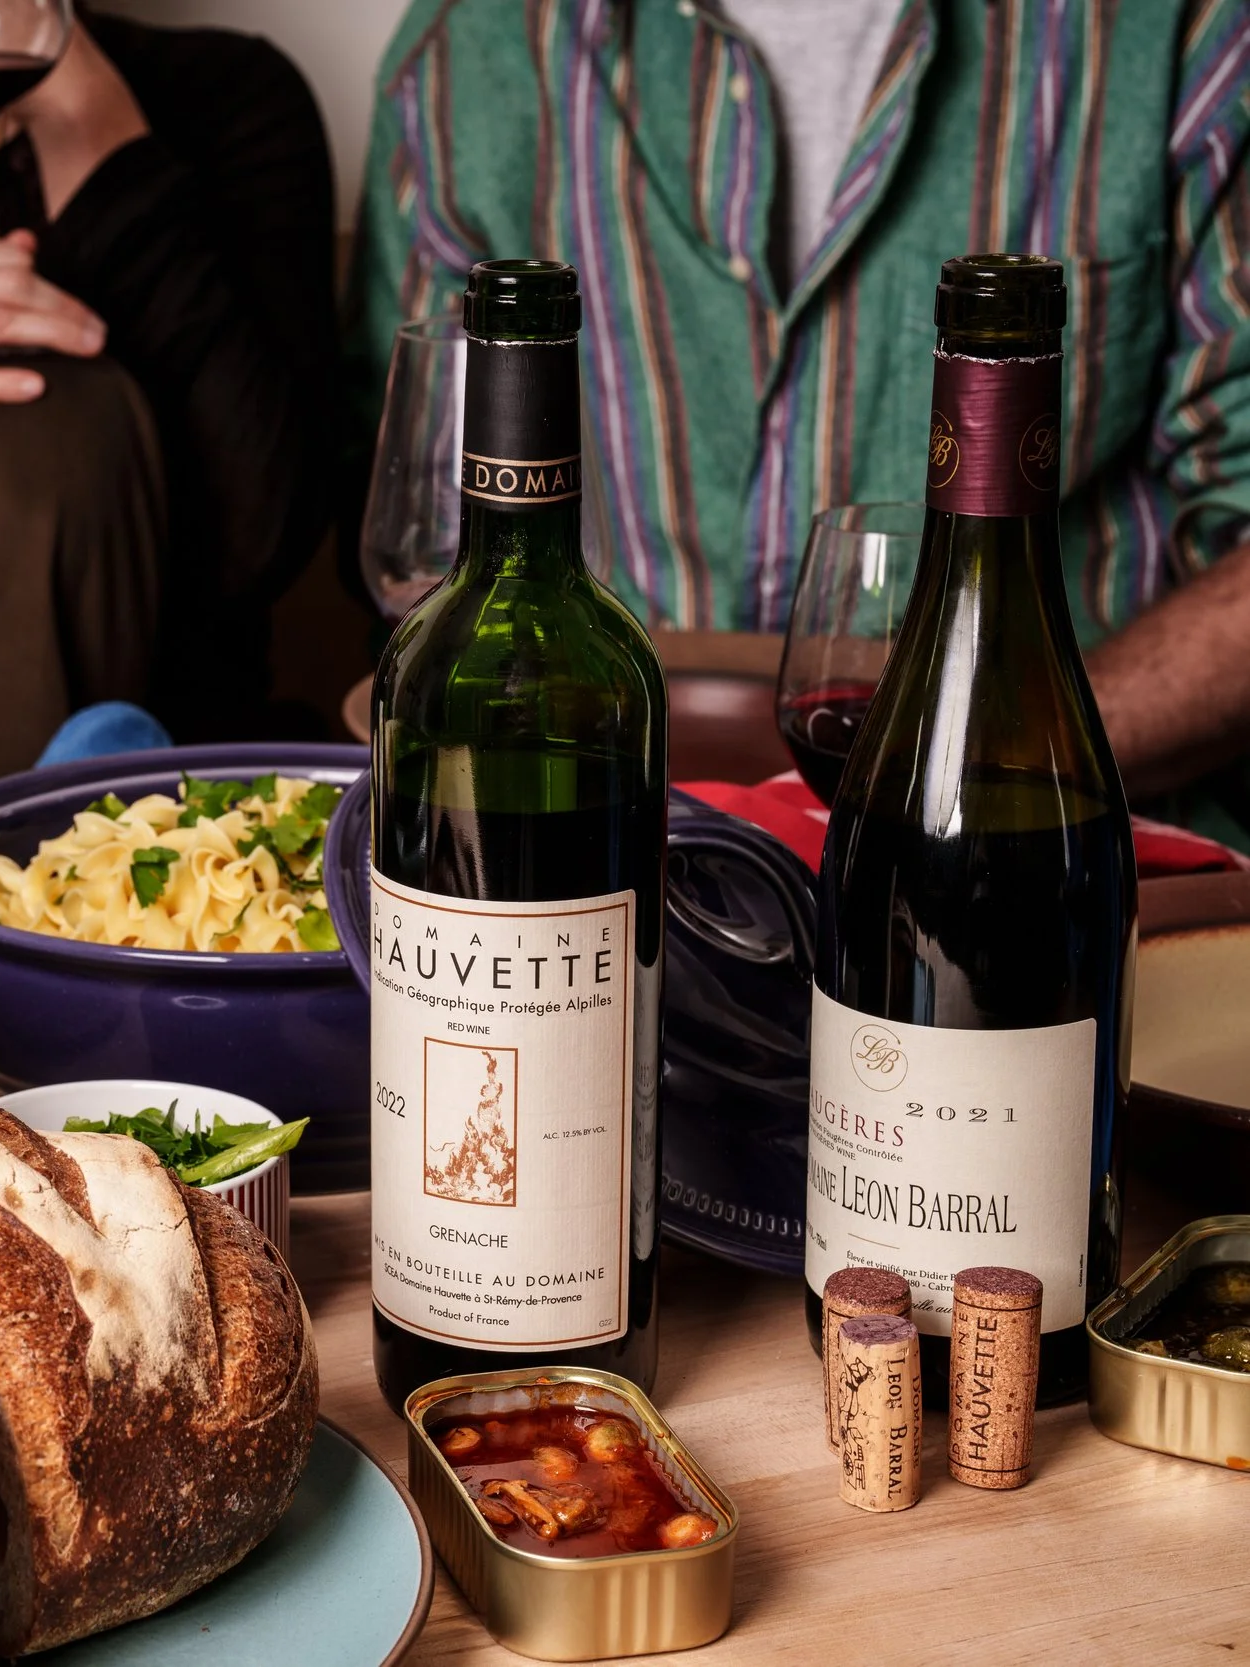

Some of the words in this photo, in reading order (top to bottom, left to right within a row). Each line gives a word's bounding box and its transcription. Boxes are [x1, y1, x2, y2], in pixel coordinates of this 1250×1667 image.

[475, 463, 581, 493] DOMAI
[374, 902, 610, 949] DOMAINE
[374, 923, 611, 990] HAUVETTE
[407, 985, 494, 1014] Géographique
[500, 1001, 561, 1017] Protégée
[565, 994, 612, 1013] Alpilles
[447, 1021, 464, 1032] RED
[465, 1025, 490, 1035] WINE
[376, 1081, 406, 1118] 2022
[905, 1102, 1019, 1123] 2021
[542, 1132, 559, 1140] ALC.
[562, 1130, 582, 1138] 12.5%
[583, 1128, 591, 1136] BY
[823, 1127, 854, 1149] Faugères
[856, 1143, 903, 1163] Contrôlée
[836, 1145, 856, 1161] WINE
[842, 1165, 899, 1225] LEON
[908, 1183, 1018, 1234] BARRAL
[429, 1224, 508, 1249] GRENACHE
[375, 1234, 385, 1252] MIS
[388, 1246, 401, 1262] EN
[406, 1256, 482, 1285] BOUTEILLE
[492, 1275, 515, 1287] AU
[526, 1266, 604, 1287] DOMAINE
[846, 1249, 865, 1265] Élevé
[866, 1259, 874, 1267] et
[902, 1269, 917, 1278] par
[919, 1270, 948, 1281] Didier
[383, 1263, 399, 1281] SCEA
[399, 1273, 432, 1293] Domaine
[434, 1285, 472, 1302] Hauvette
[474, 1294, 481, 1303] à
[483, 1294, 582, 1308] St-Rémy-de-Provence
[429, 1305, 461, 1321] Product
[463, 1312, 474, 1323] of
[476, 1314, 509, 1326] France
[935, 1306, 954, 1314] au
[887, 1359, 906, 1410] LEON
[952, 1313, 968, 1461] DOMAINE
[968, 1317, 998, 1461] HAUVETTE
[912, 1375, 921, 1470] DOMAINE
[887, 1425, 908, 1499] BARRAL
